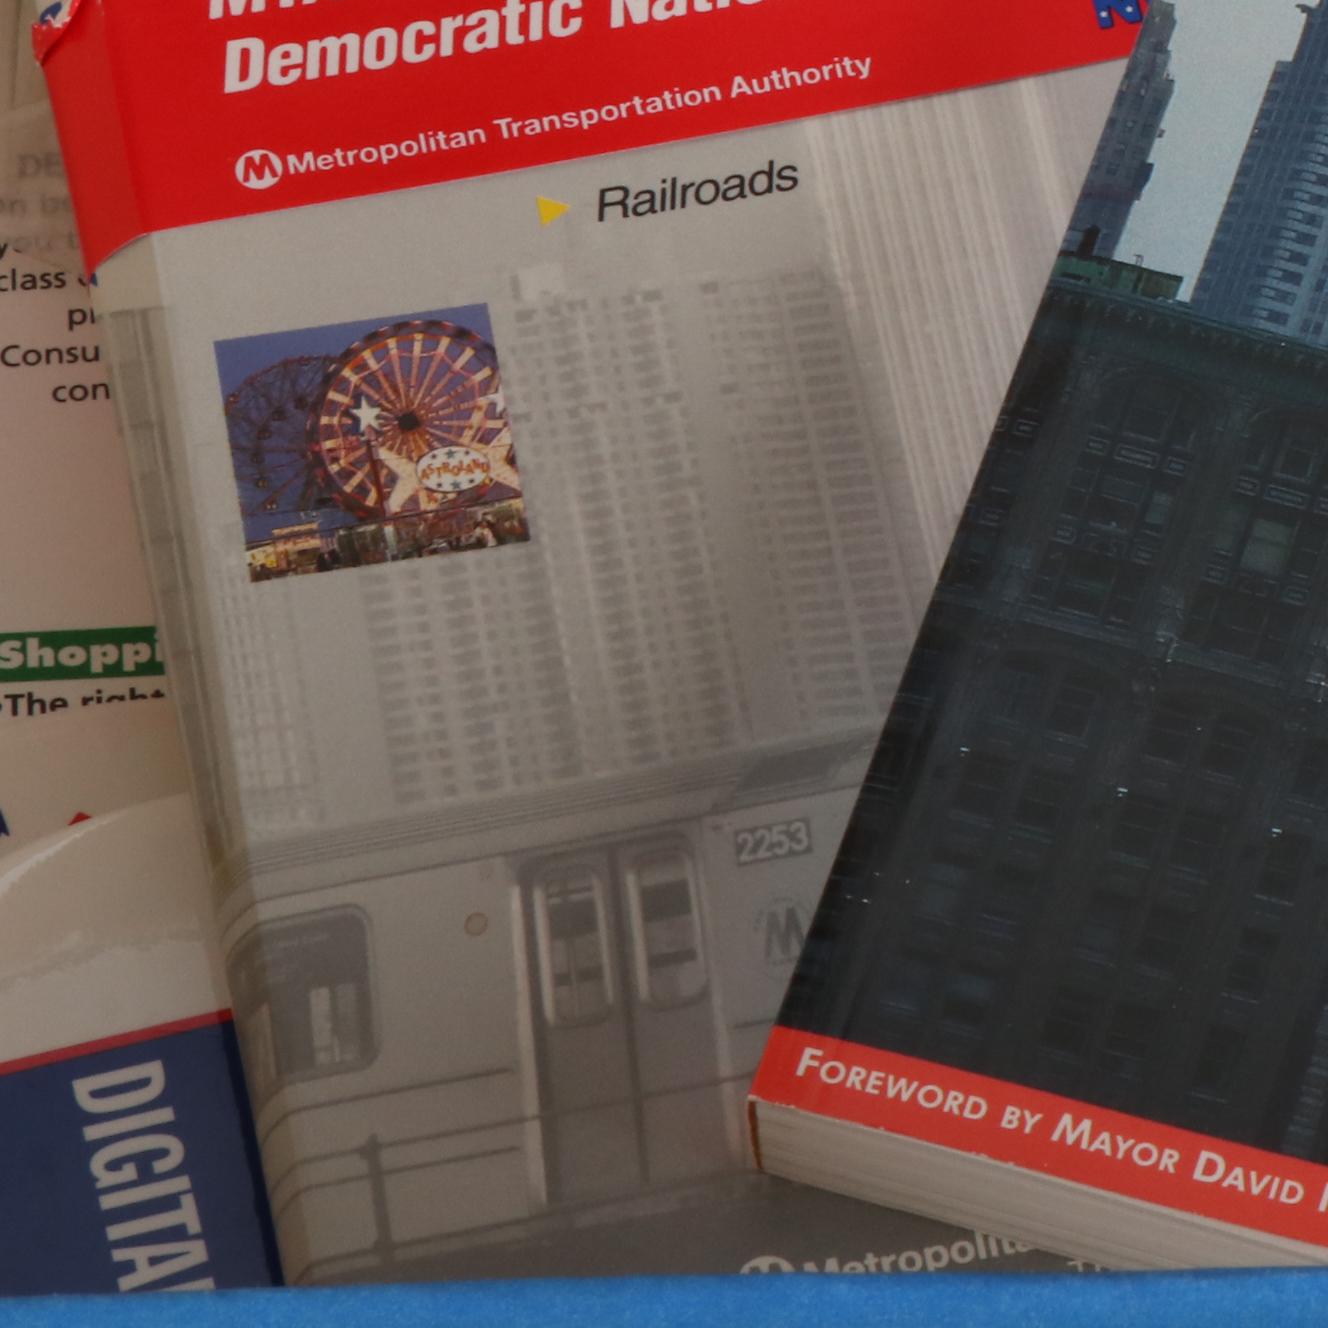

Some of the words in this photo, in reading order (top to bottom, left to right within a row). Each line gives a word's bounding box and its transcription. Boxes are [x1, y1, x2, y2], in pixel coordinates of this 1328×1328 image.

[286, 124, 487, 176] Metropolitan
[493, 82, 722, 141] Transportation
[730, 57, 873, 99] Authority
[597, 160, 800, 222] Railroads
[737, 820, 809, 863] 2253
[796, 1046, 988, 1121] FOREWORD
[1001, 1105, 1043, 1135] BY
[1050, 1112, 1181, 1174] MAYOR
[1192, 1150, 1305, 1206] DAVID
